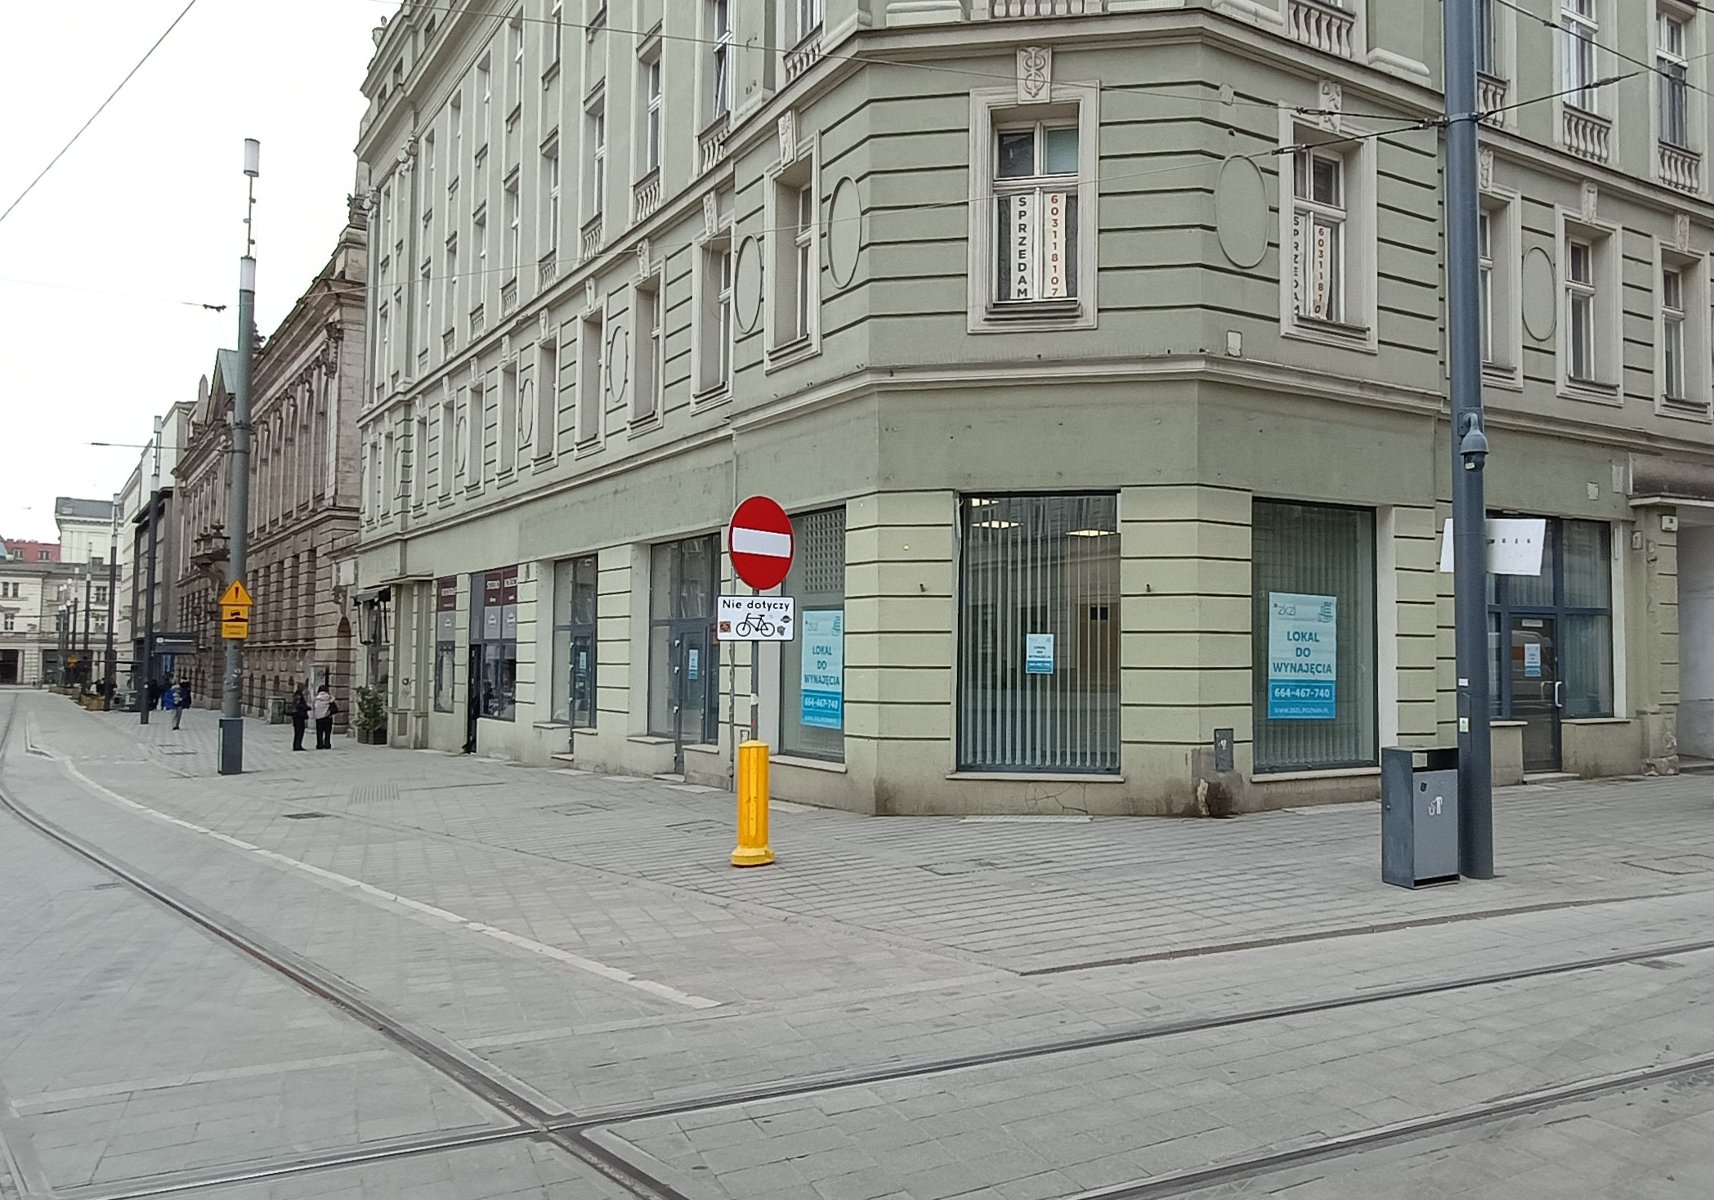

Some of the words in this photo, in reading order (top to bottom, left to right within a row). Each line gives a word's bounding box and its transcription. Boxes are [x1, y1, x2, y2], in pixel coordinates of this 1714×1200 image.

[1017, 197, 1028, 297] SPRZEDAM
[1051, 195, 1059, 296] 603118107
[1314, 228, 1325, 319] 60311810
[722, 599, 742, 609] Nie
[747, 600, 790, 611] dotyczy
[1287, 631, 1320, 642] LOKAL
[812, 645, 833, 656] LOKAL
[1296, 647, 1311, 657] DO
[817, 660, 827, 670] DO
[1272, 662, 1332, 675] WYNAJĘCIA
[803, 674, 840, 686] WYNAJĘCIA
[1274, 688, 1330, 698] 664-467-740
